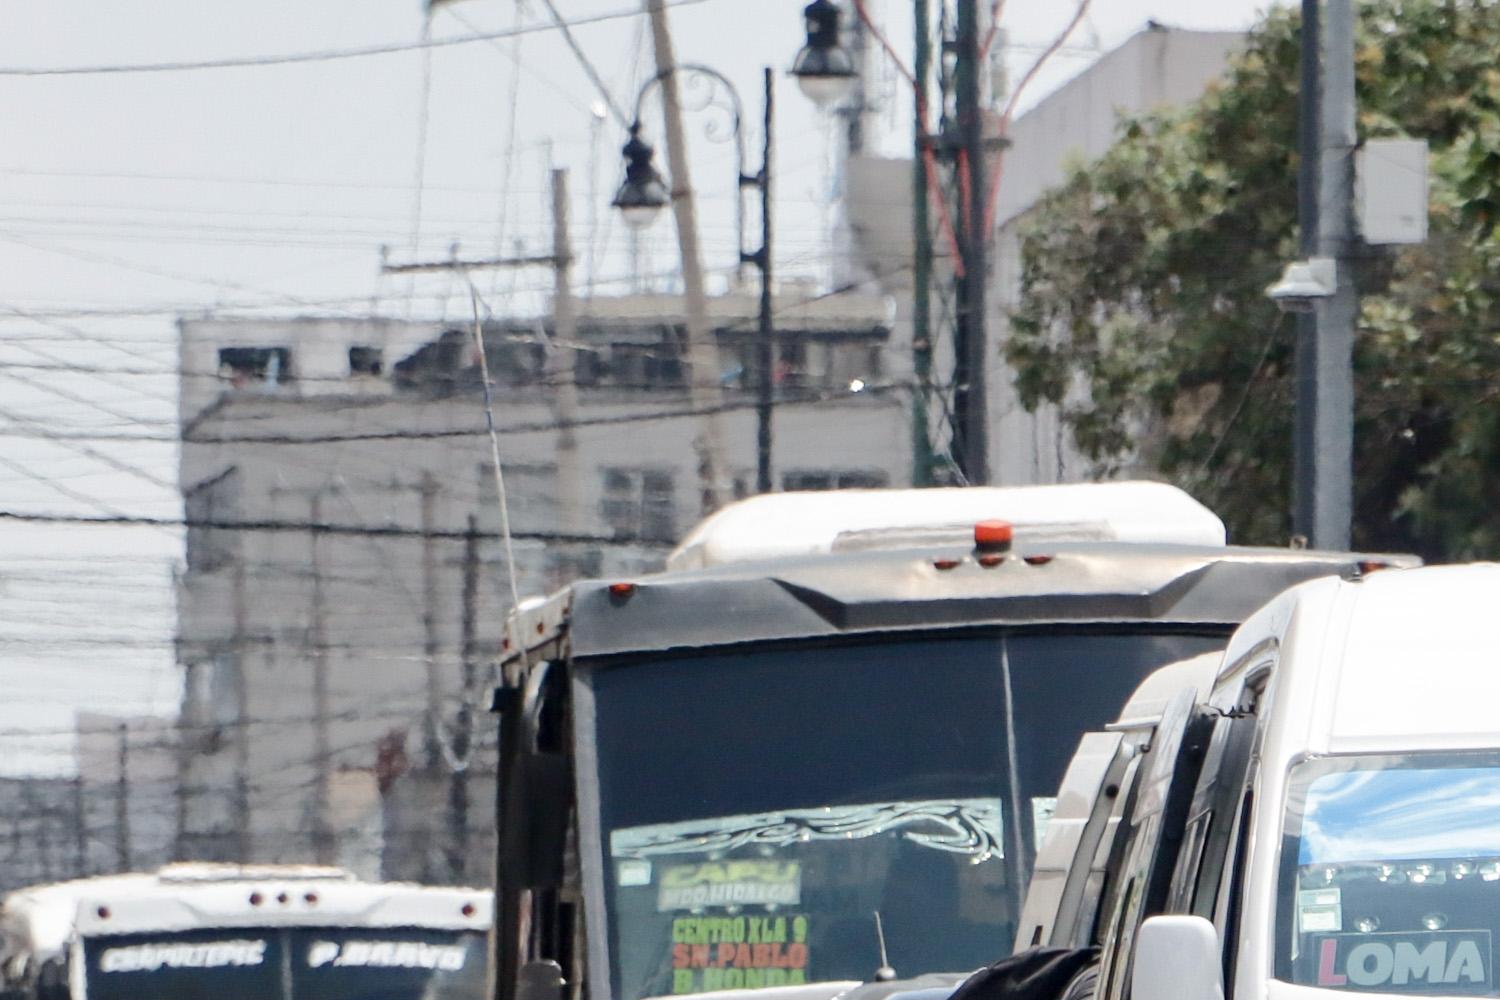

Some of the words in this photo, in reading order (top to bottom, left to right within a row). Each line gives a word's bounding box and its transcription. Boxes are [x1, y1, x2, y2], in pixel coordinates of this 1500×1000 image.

[660, 860, 799, 887] CAPU
[673, 916, 745, 943] CENTRO
[1318, 939, 1486, 986] LOMA
